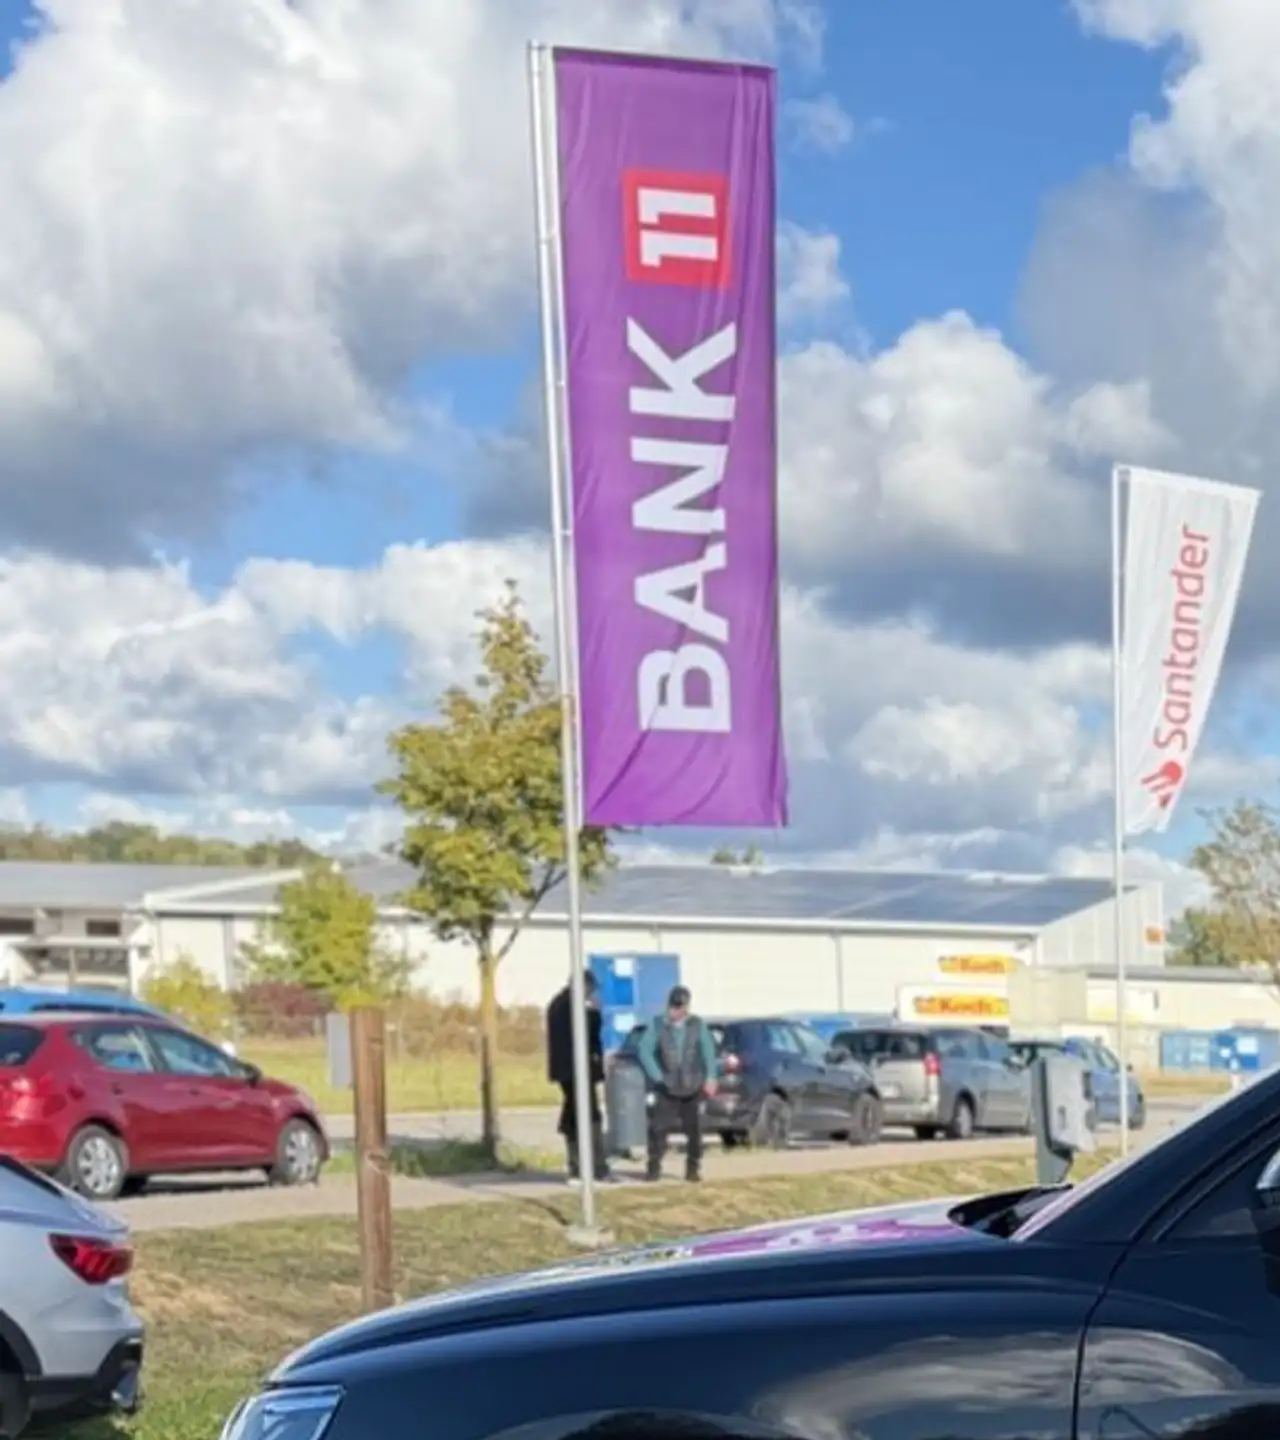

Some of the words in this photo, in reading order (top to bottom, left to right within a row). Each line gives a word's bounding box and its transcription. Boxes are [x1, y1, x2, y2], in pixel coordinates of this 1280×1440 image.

[636, 187, 719, 269] 11
[626, 316, 737, 733] BANK
[1152, 521, 1211, 752] Santander
